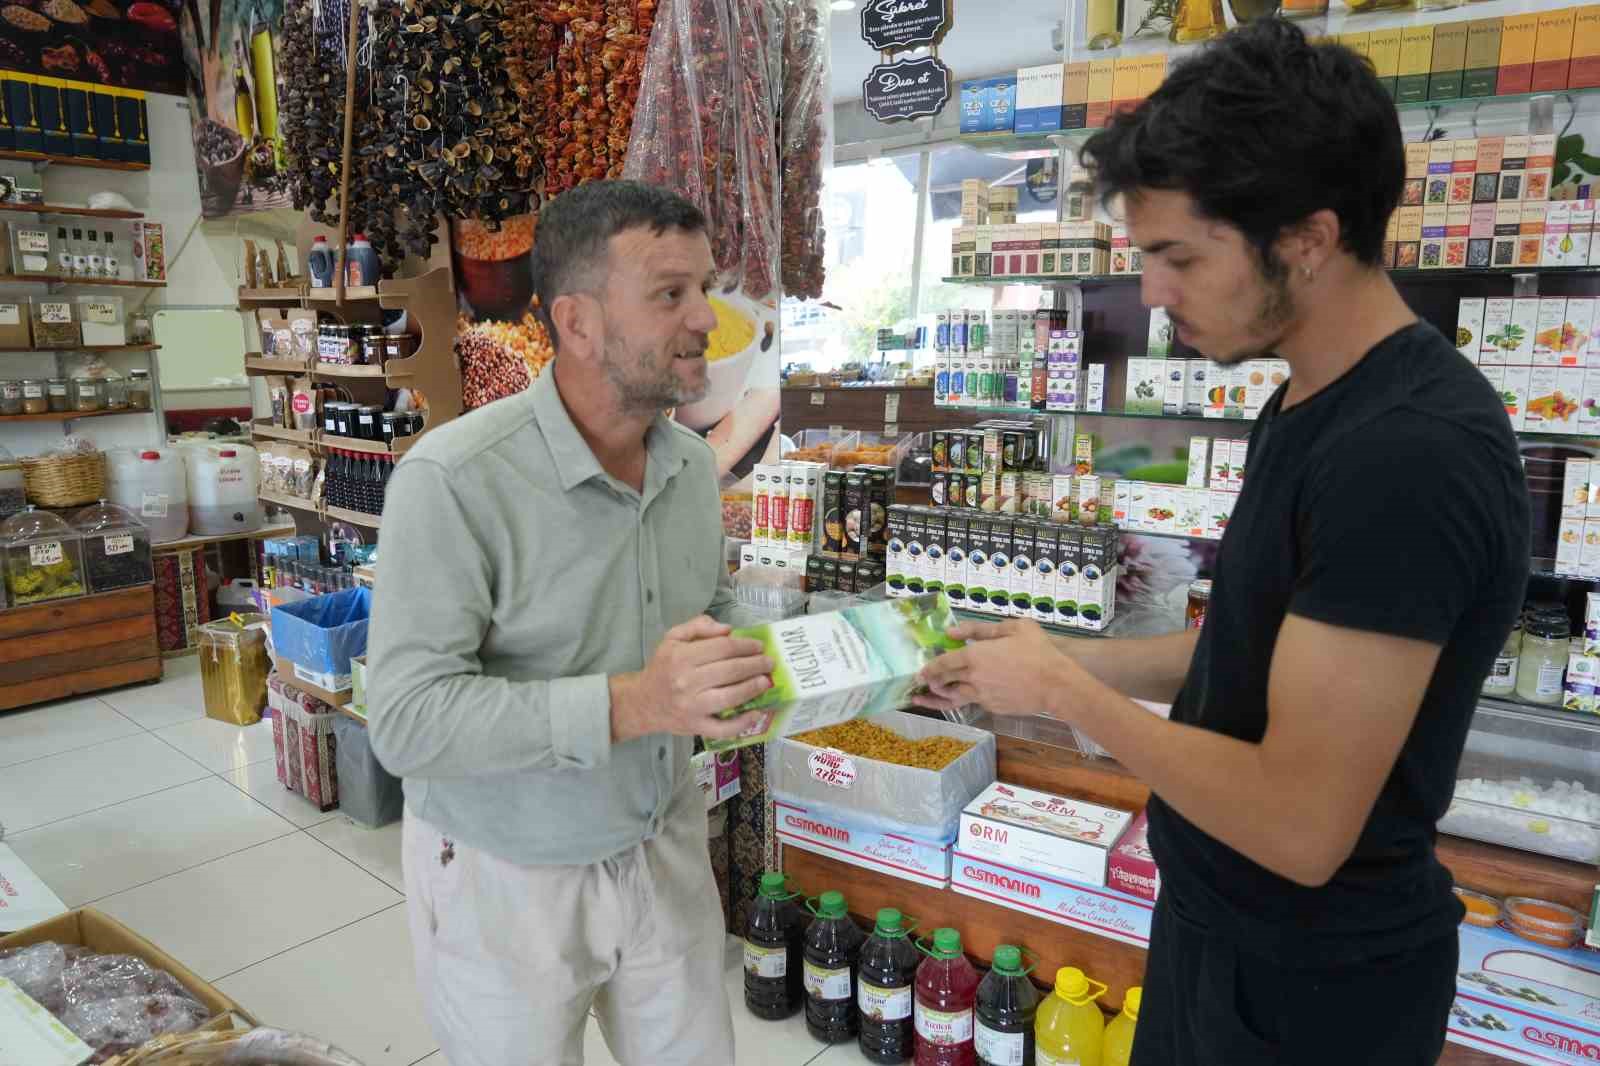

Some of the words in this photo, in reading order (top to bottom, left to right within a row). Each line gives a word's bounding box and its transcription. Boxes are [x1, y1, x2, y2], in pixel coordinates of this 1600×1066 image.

[879, 72, 914, 93] Dua
[917, 71, 931, 84] et
[969, 822, 1009, 846] ORM
